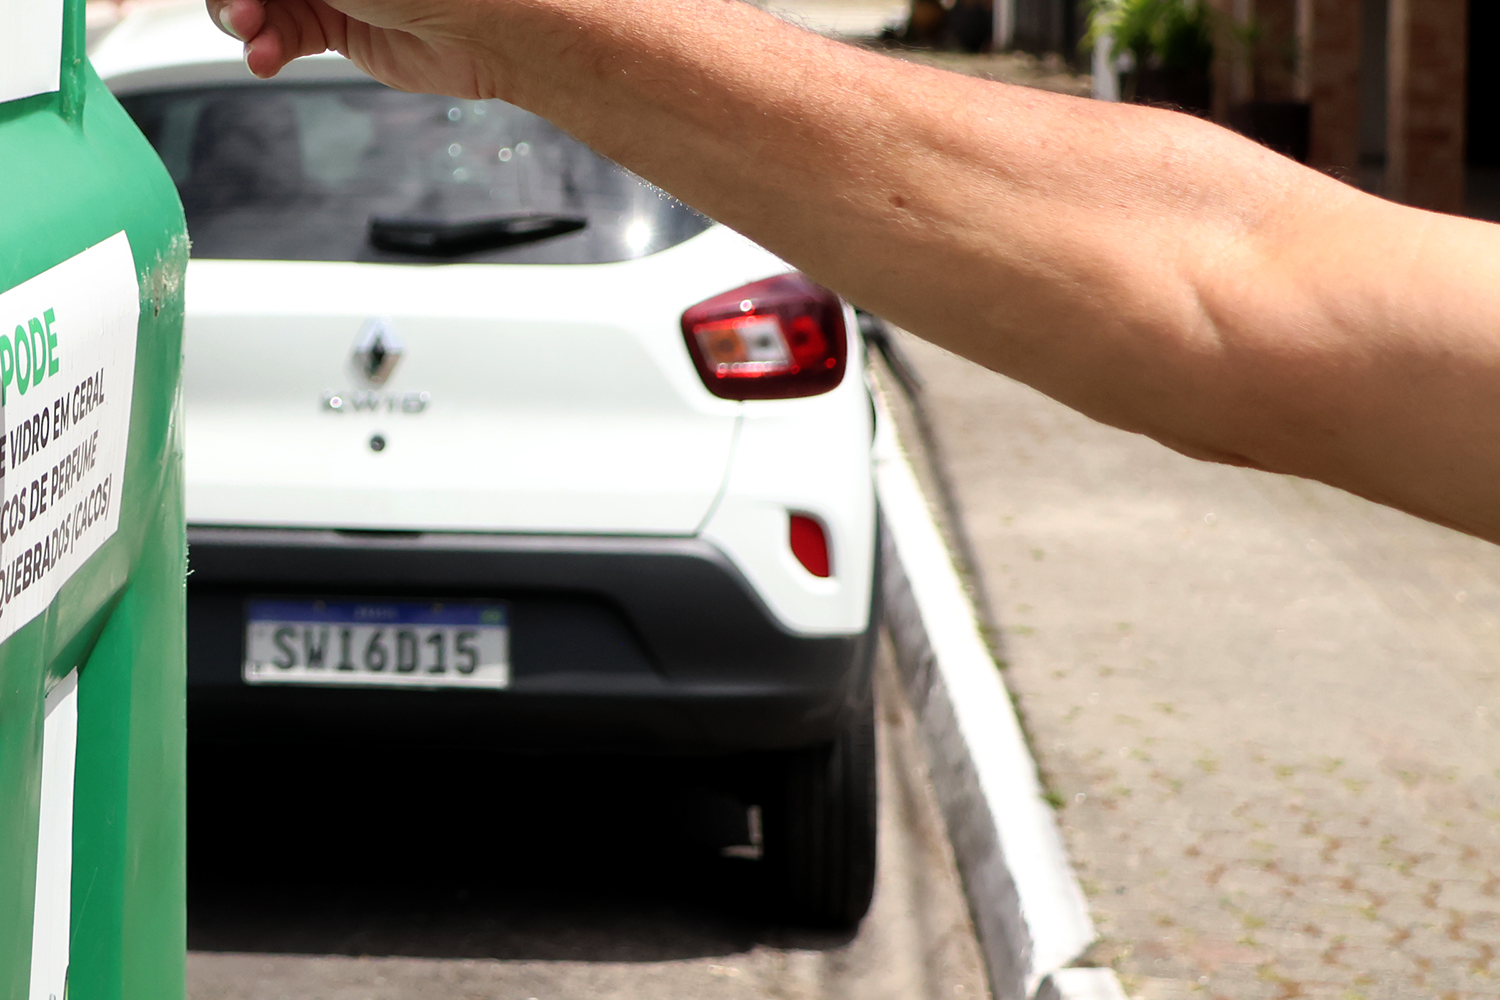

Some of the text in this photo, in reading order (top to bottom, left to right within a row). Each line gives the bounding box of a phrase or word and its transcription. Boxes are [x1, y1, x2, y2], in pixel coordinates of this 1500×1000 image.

[10, 407, 49, 470] VIDRO
[53, 392, 70, 441] EM
[72, 367, 105, 425] GERAL
[29, 472, 48, 522] DE
[51, 430, 98, 506] PERFUME
[272, 626, 481, 675] SWI6D15
